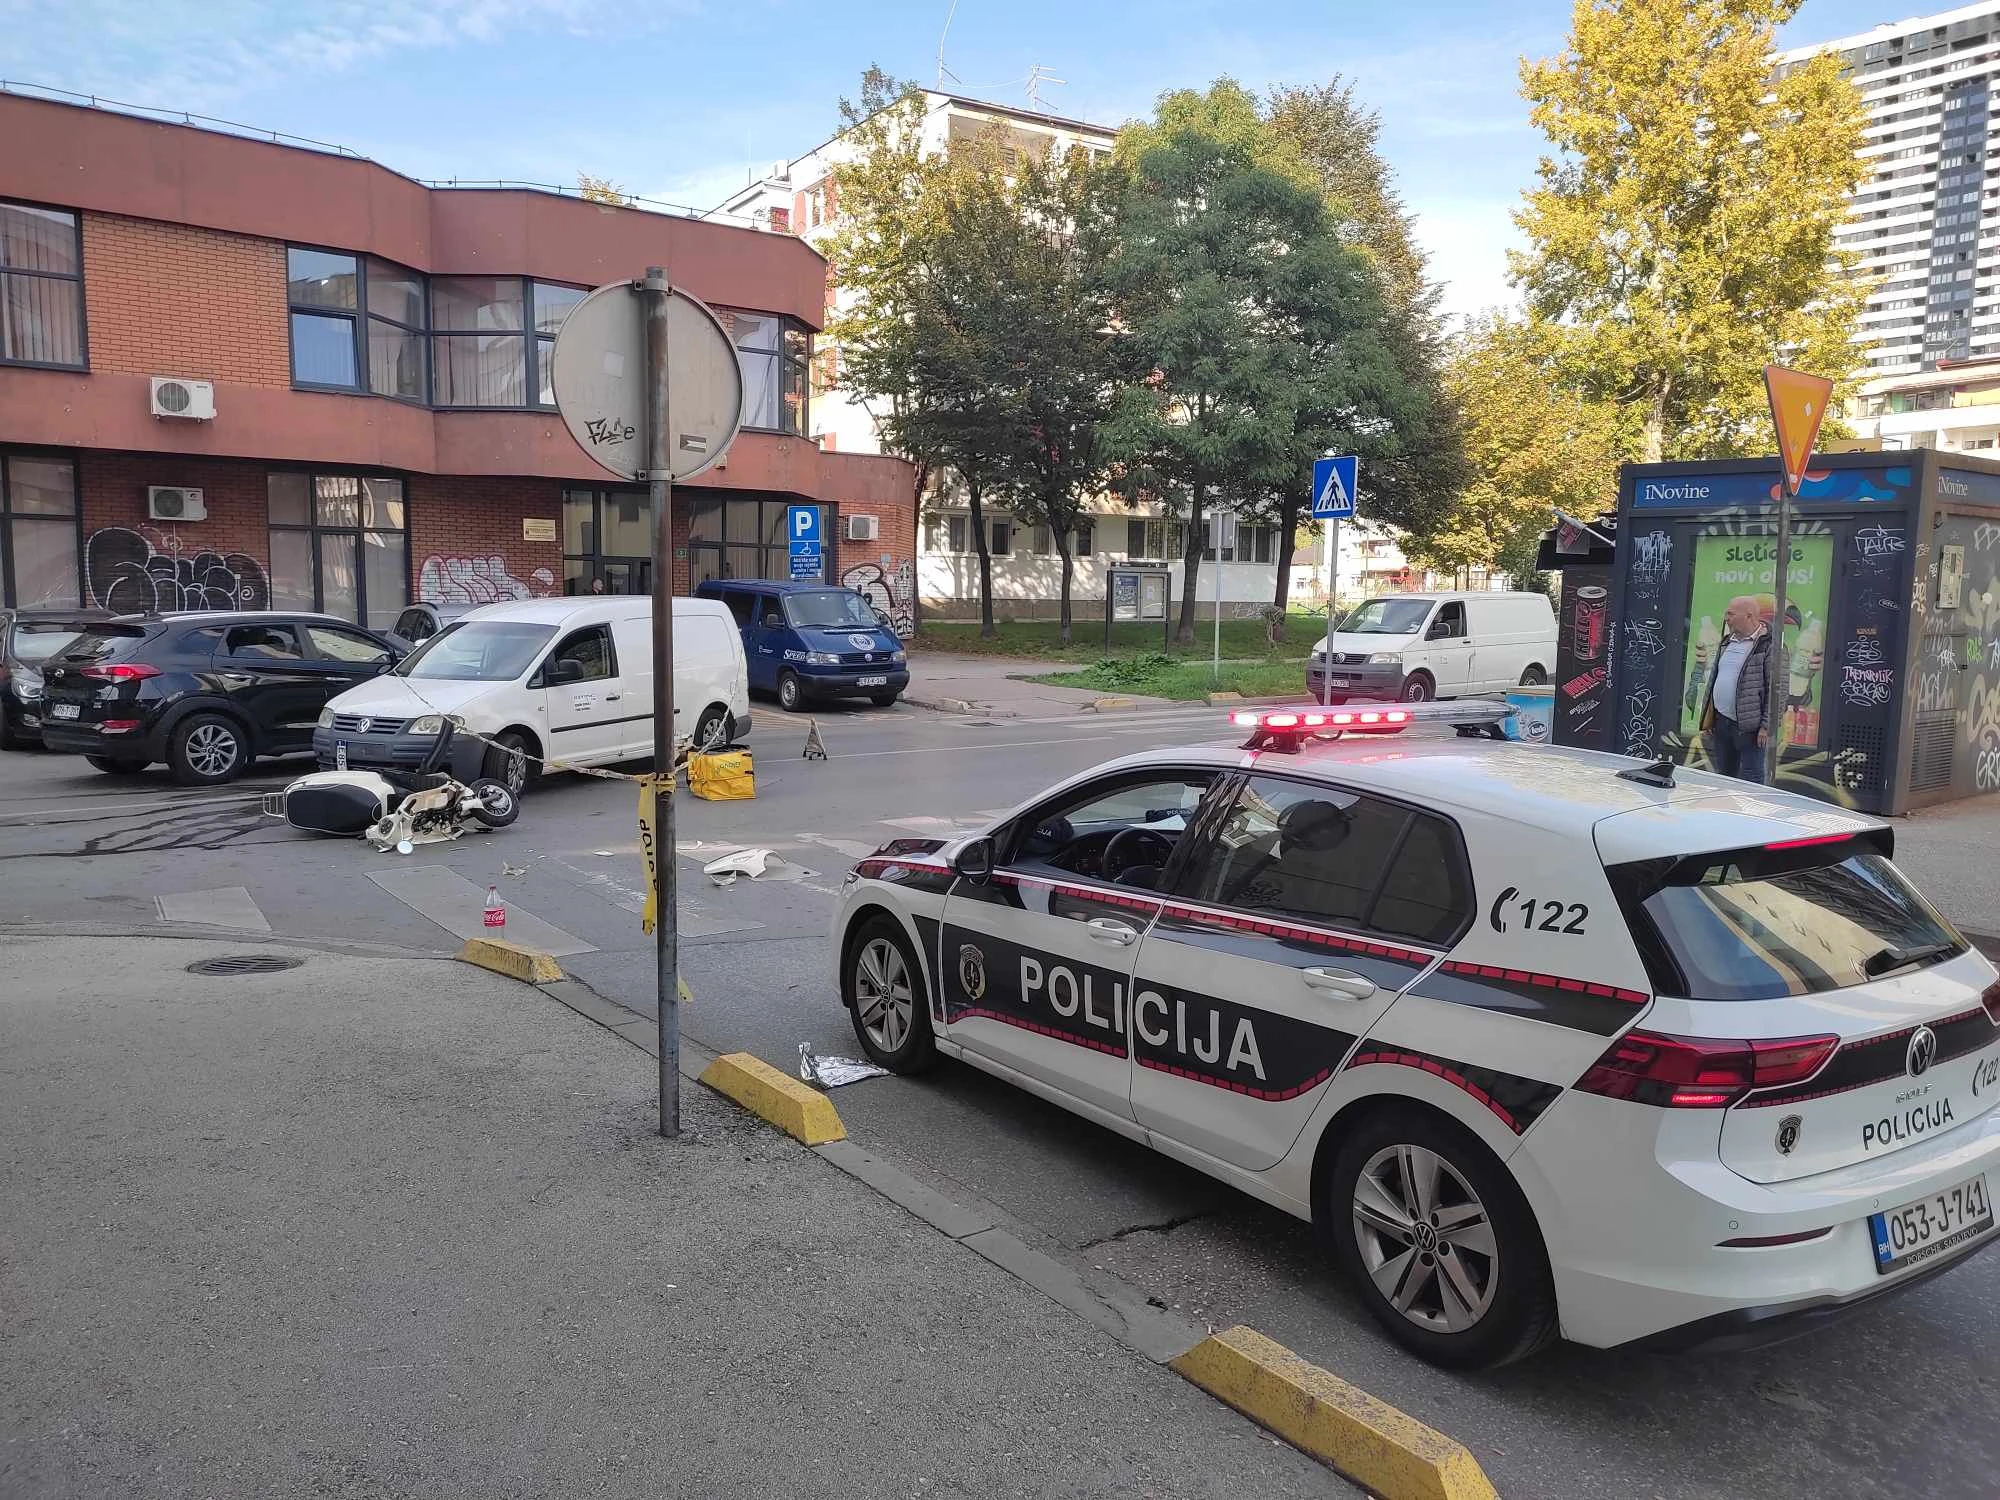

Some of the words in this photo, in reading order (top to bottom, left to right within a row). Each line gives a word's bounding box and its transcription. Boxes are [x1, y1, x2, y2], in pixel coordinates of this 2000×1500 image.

[1645, 483, 1710, 500] iNovine
[1938, 475, 1969, 497] iNovine
[795, 511, 813, 537] P
[1712, 566, 1754, 585] novi
[1520, 898, 1589, 935] 122
[1019, 954, 1267, 1081] POLICIJA
[1982, 1056, 1999, 1088] 122
[1862, 1097, 1954, 1151] POLICIJA
[1890, 1180, 1987, 1250] 053-J-741
